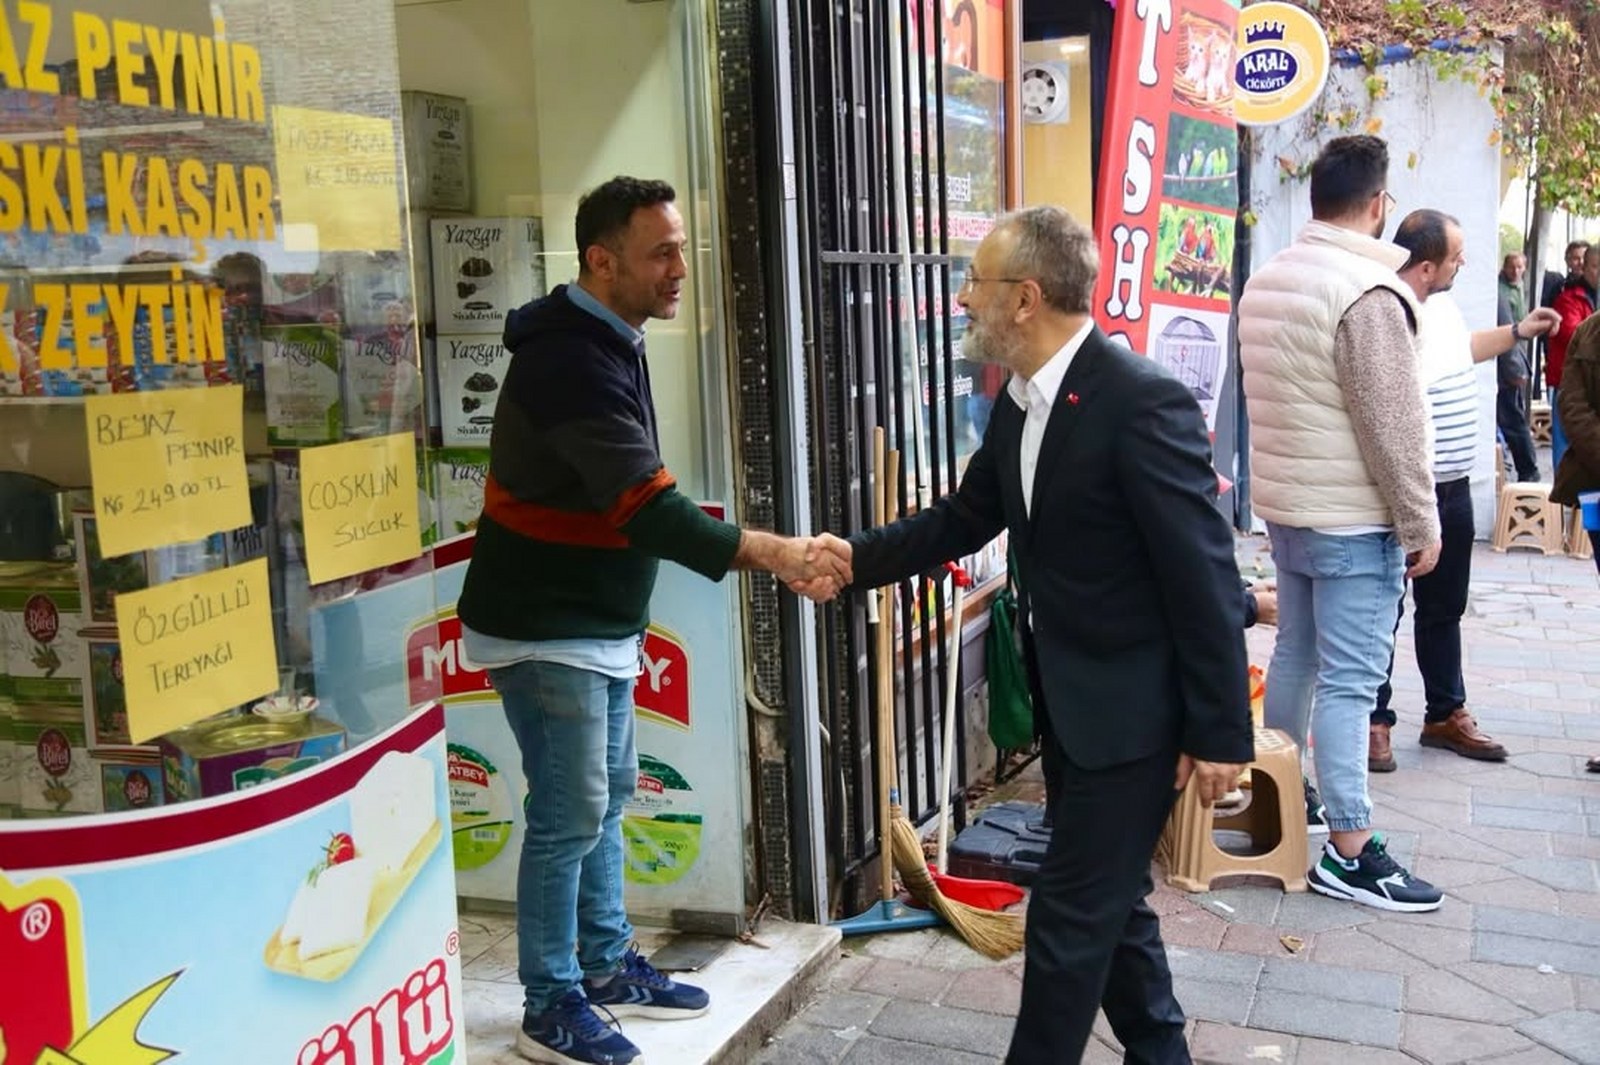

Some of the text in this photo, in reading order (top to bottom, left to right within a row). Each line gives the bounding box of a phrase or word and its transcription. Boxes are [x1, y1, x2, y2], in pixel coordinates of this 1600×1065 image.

[73, 11, 265, 123] PEYNİR
[1243, 52, 1290, 75] KRAL
[103, 151, 276, 264] KAŞAR
[445, 224, 503, 251] Yazgan
[34, 265, 227, 370] ZEYTİN
[449, 340, 505, 367] Yazgan
[97, 410, 184, 445] BEYAZ
[449, 458, 488, 487] Yazg
[333, 512, 412, 548] SUCUK
[449, 765, 485, 781] ATBEY
